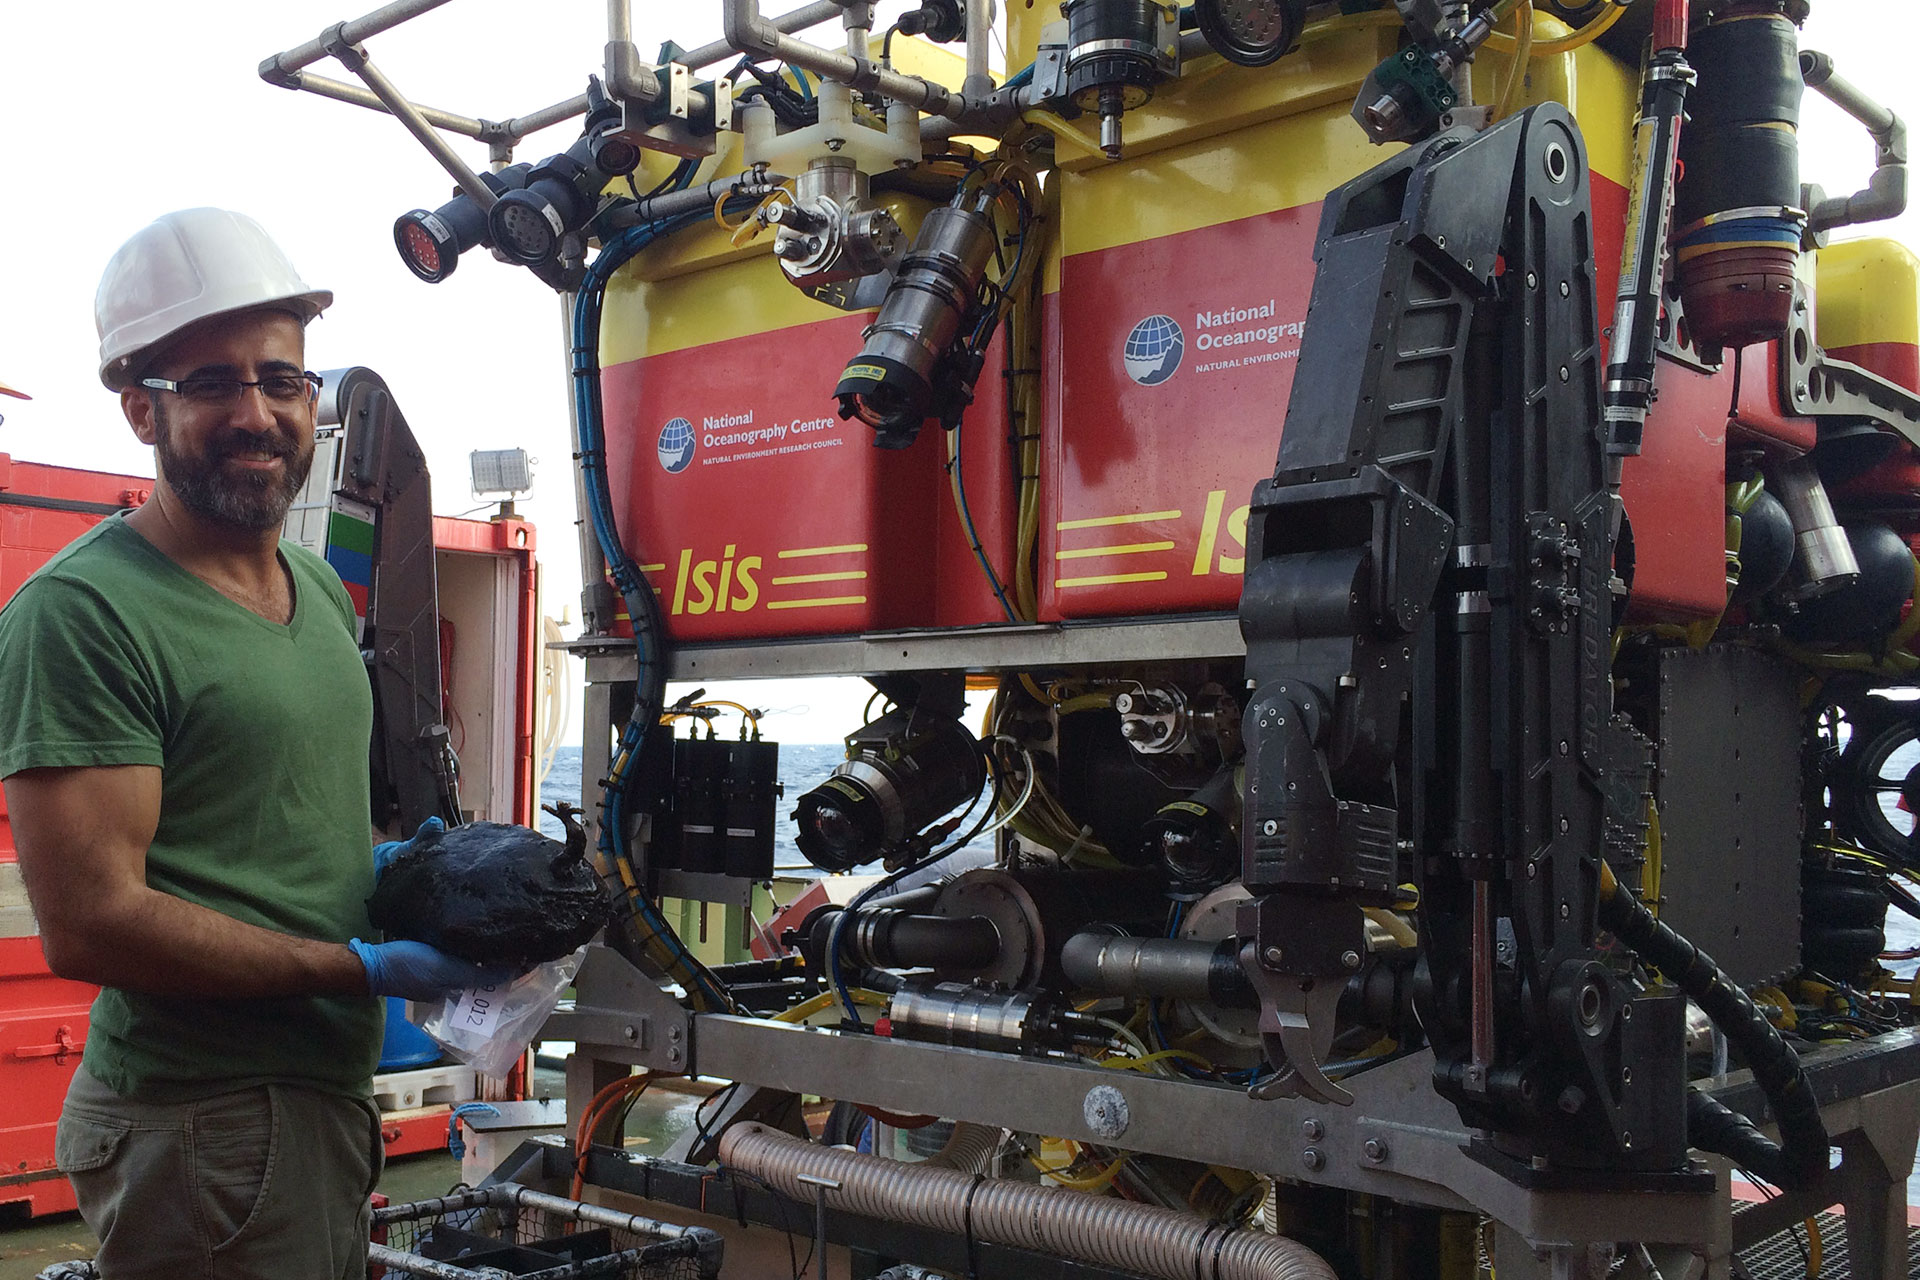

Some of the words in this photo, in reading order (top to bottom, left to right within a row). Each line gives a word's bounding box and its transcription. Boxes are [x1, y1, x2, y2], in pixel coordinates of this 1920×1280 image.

[1196, 299, 1275, 329] National
[1196, 359, 1241, 373] NATURAL
[703, 409, 753, 431] National
[703, 423, 788, 448] Oceanography
[790, 417, 835, 434] Centre
[703, 455, 732, 466] NATURAL
[732, 448, 778, 462] ENVIRONMENT
[778, 442, 811, 454] RESEARCH
[812, 437, 843, 449] COUNCIL
[671, 544, 762, 616] Isis
[1583, 567, 1598, 753] PREDATOR
